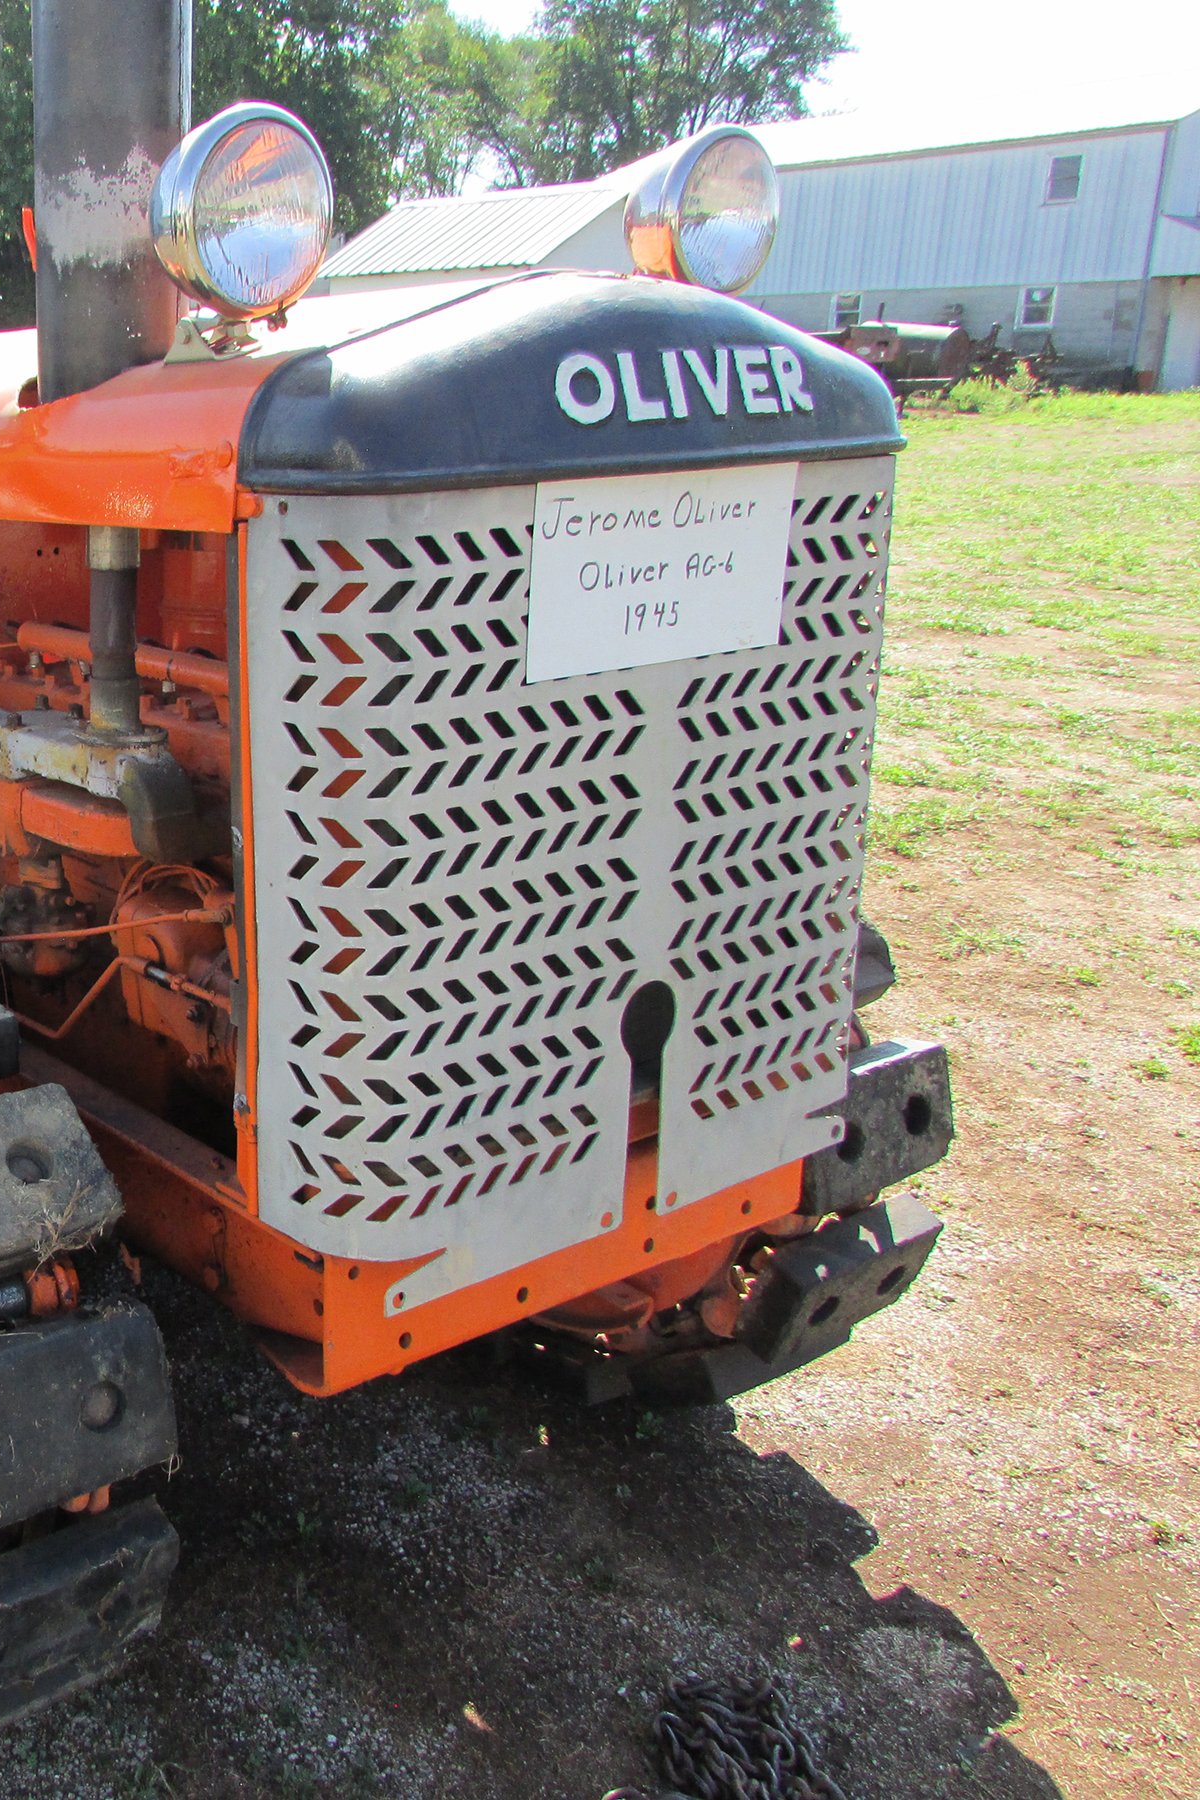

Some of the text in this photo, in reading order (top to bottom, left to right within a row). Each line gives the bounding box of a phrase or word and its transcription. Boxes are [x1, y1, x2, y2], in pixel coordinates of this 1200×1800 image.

[555, 346, 814, 425] OLIVER
[542, 497, 662, 540] Jerome
[685, 551, 734, 580] AG-6
[623, 600, 680, 636] 1945
